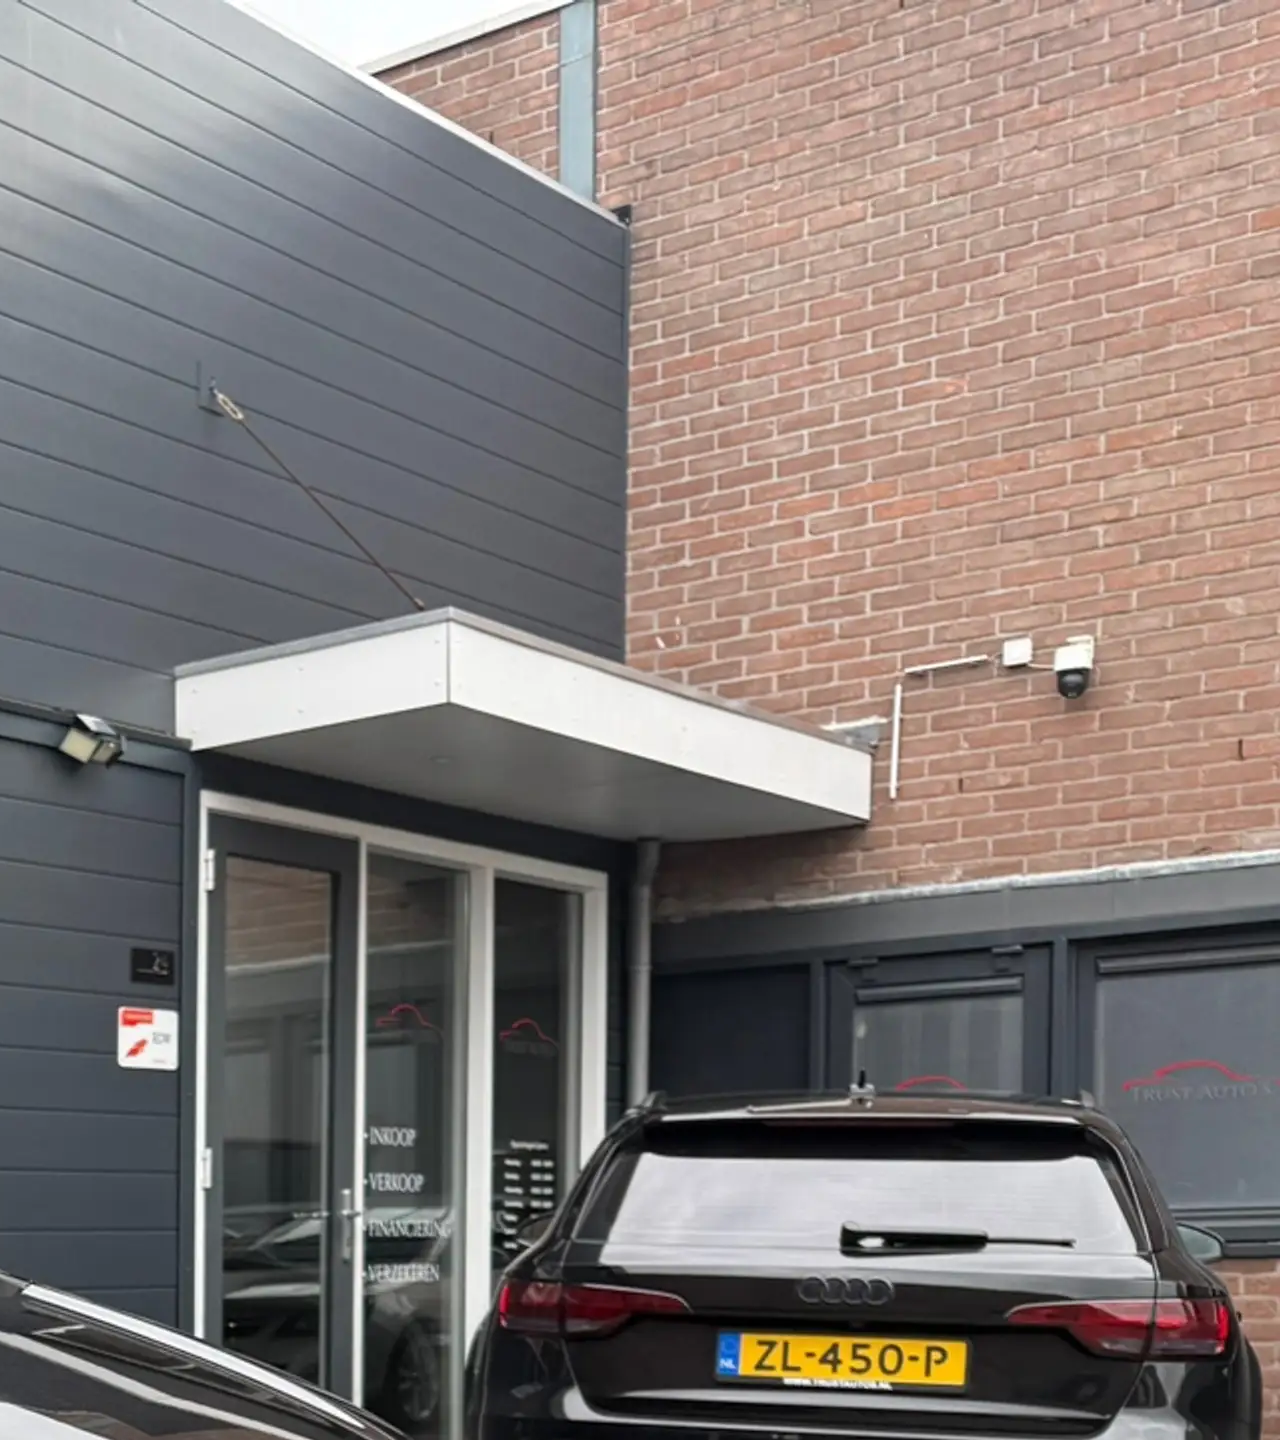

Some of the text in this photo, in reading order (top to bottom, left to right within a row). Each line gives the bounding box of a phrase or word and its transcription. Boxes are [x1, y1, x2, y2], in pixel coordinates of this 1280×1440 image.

[369, 1127, 416, 1147] INKOOP
[369, 1172, 425, 1193] VERKOOP
[719, 1358, 736, 1369] NL
[753, 1340, 949, 1378] ZL-450-P
